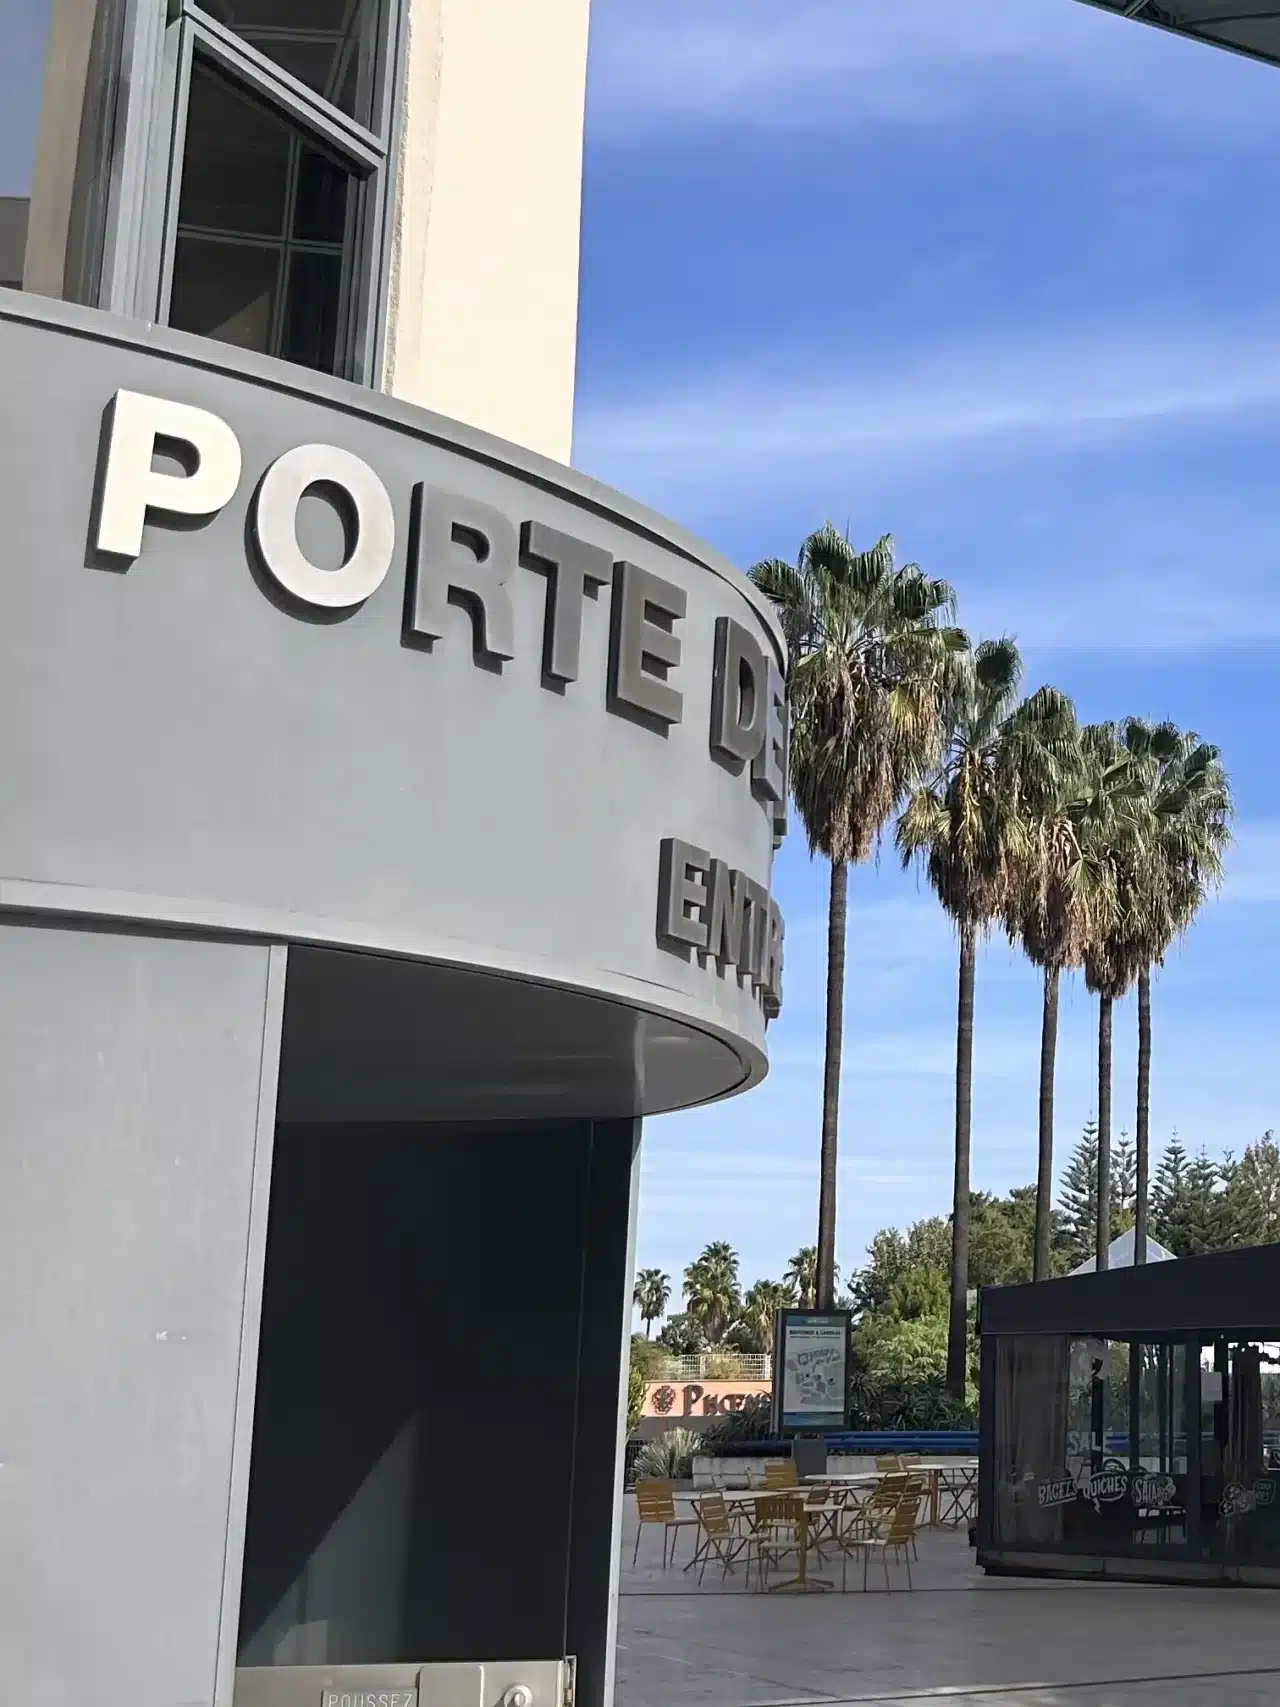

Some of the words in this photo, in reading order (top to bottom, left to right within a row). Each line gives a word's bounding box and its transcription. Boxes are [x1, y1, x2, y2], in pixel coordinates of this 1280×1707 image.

[85, 388, 686, 737] PORTE
[1083, 1476, 1128, 1500] QUICHES
[329, 1693, 412, 1707] POUSSEZ
